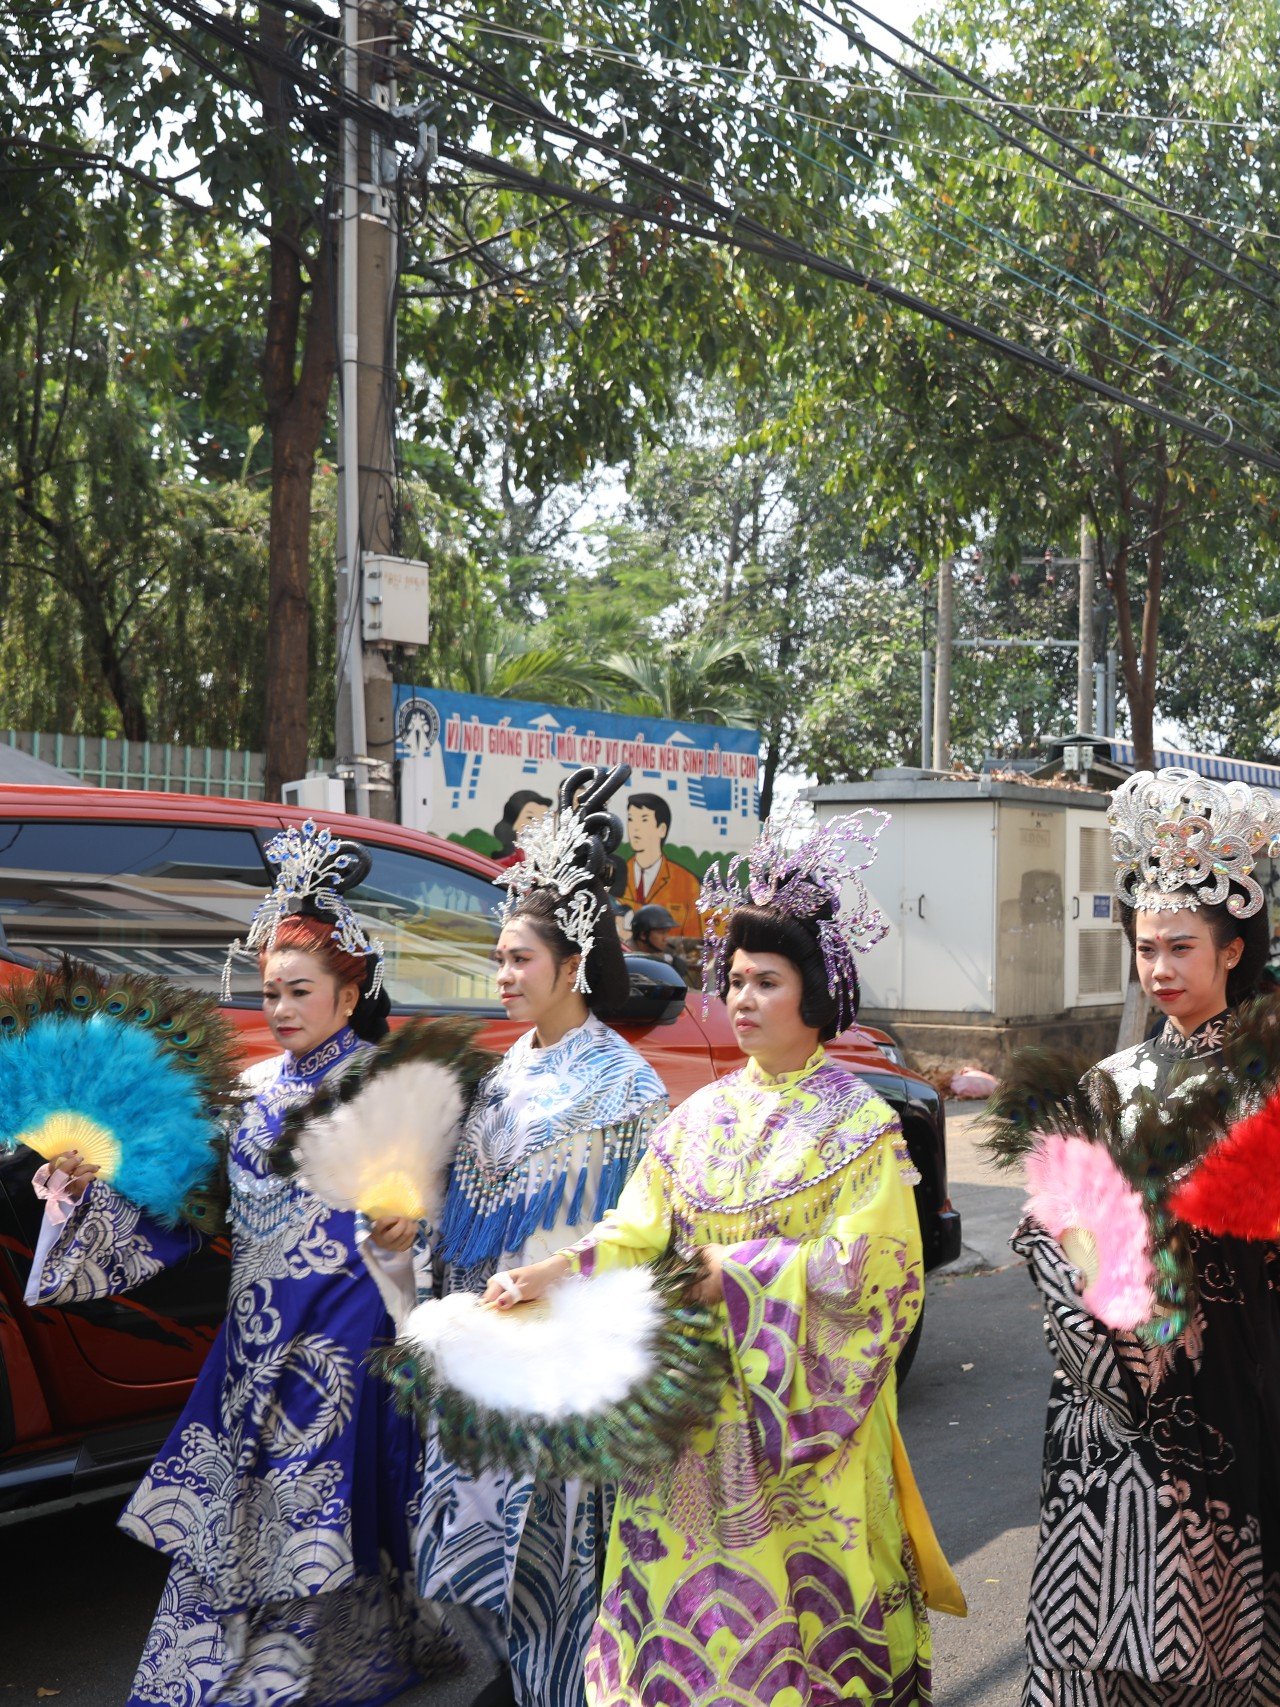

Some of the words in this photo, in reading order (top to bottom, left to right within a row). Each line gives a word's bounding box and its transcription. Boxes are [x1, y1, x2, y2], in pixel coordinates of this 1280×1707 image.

[446, 714, 460, 750] VÌ
[463, 717, 484, 752] NÒI
[488, 717, 522, 756] GIỐNG
[622, 734, 656, 769] CHỒNG
[659, 741, 679, 771] NÊN
[683, 750, 704, 774] SINH
[722, 754, 738, 777] HAI
[740, 755, 756, 779] CON
